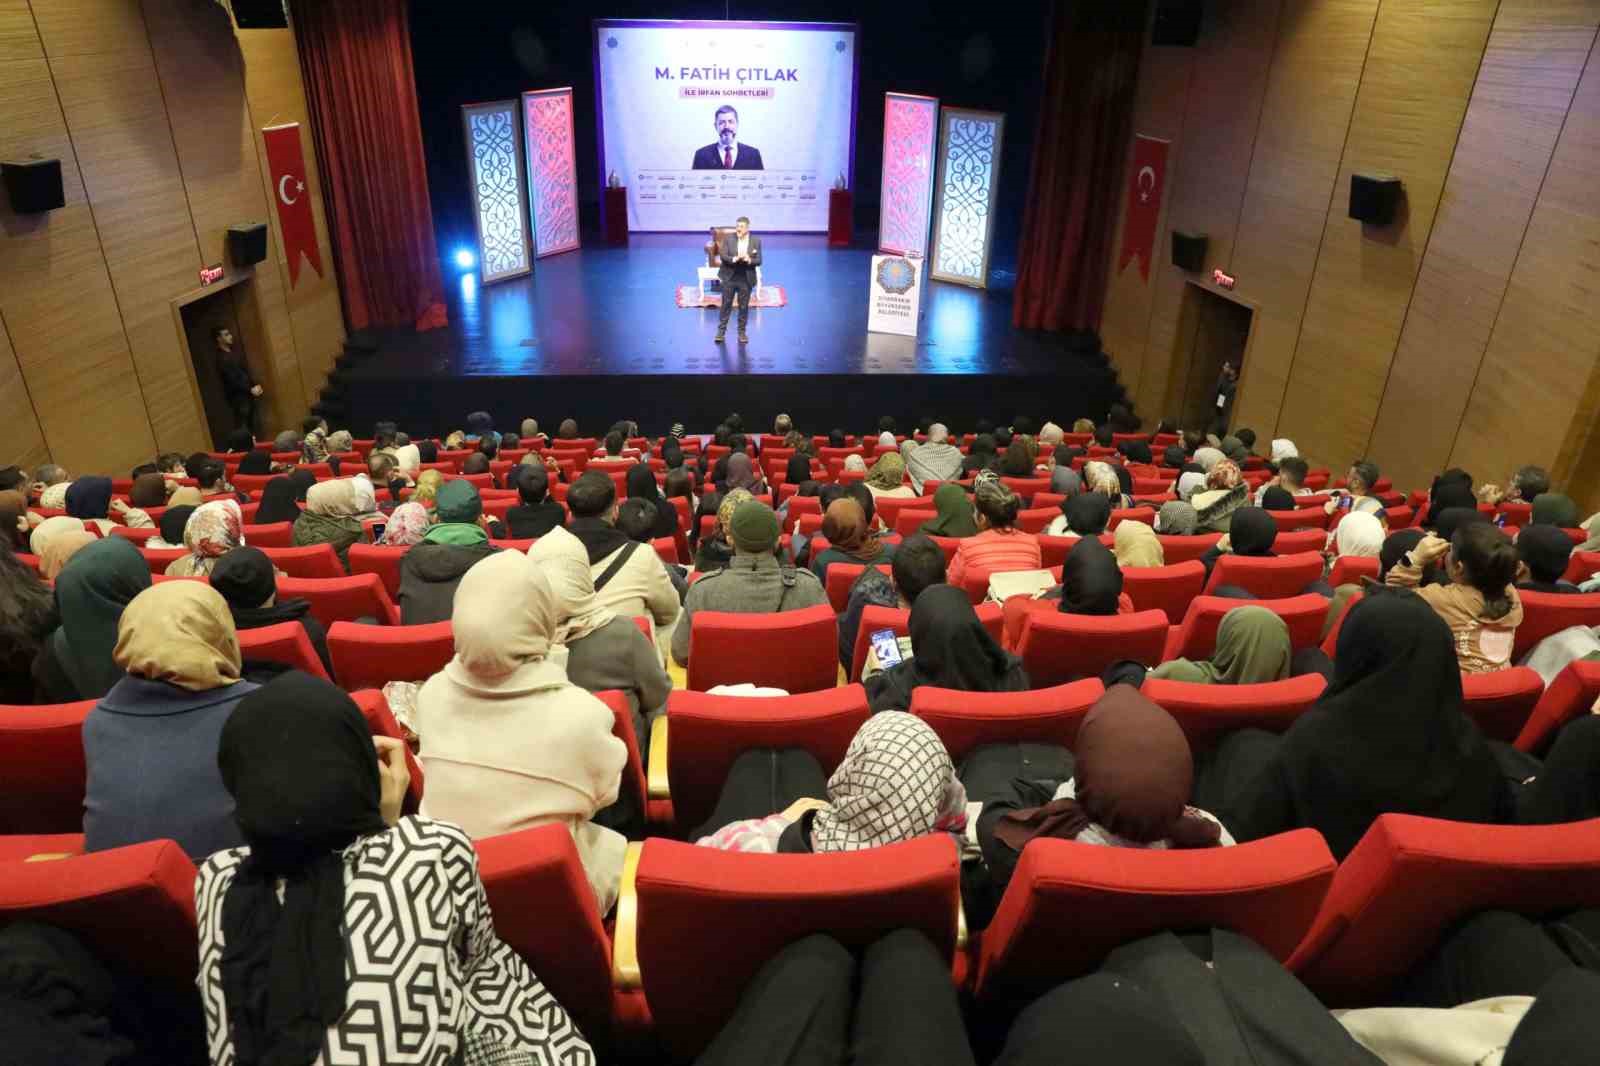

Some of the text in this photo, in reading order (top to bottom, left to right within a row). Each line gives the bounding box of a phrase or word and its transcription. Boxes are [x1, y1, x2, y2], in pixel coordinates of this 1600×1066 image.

[655, 64, 798, 84] M. FATİH ÇITLAK
